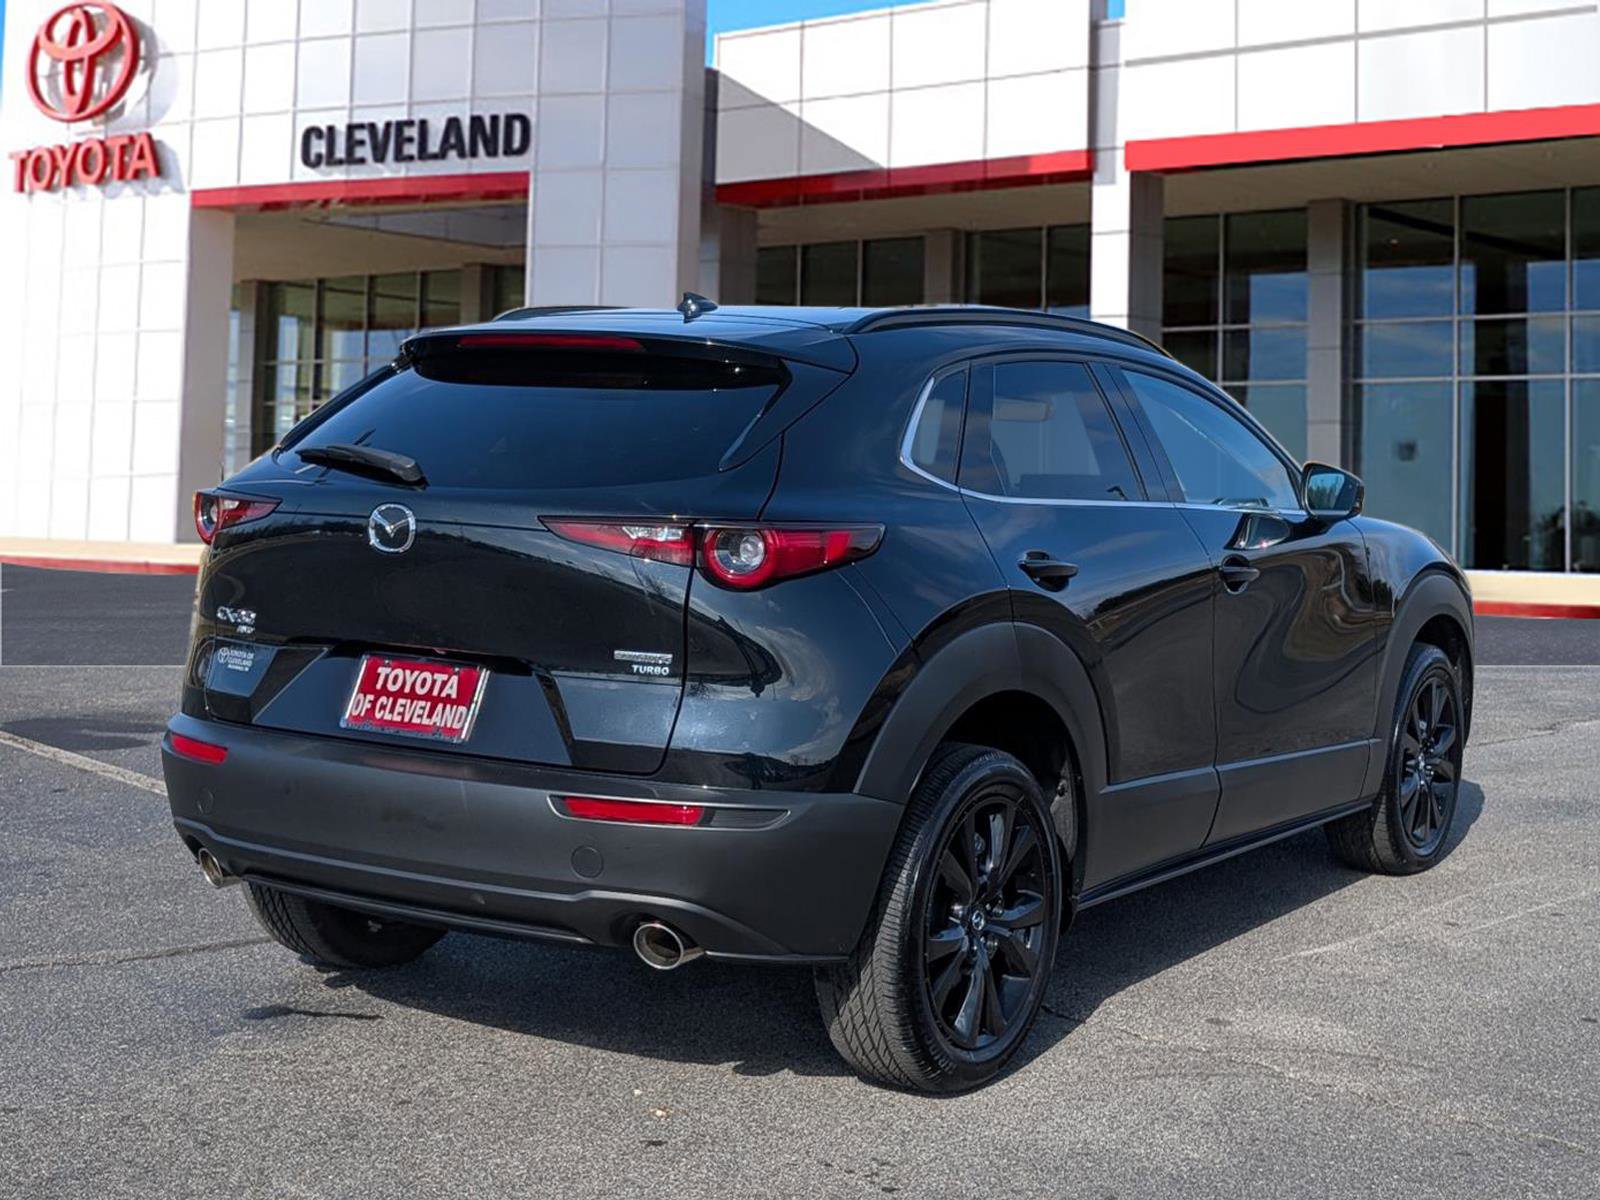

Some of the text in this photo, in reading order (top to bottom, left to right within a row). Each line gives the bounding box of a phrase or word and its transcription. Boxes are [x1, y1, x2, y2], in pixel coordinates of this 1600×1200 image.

[301, 113, 531, 169] CLEVELAND
[9, 132, 160, 193] TOYOTA
[375, 666, 460, 700] TOYOTA
[631, 664, 670, 676] TURBO
[351, 693, 469, 730] OF CLEVELAND
